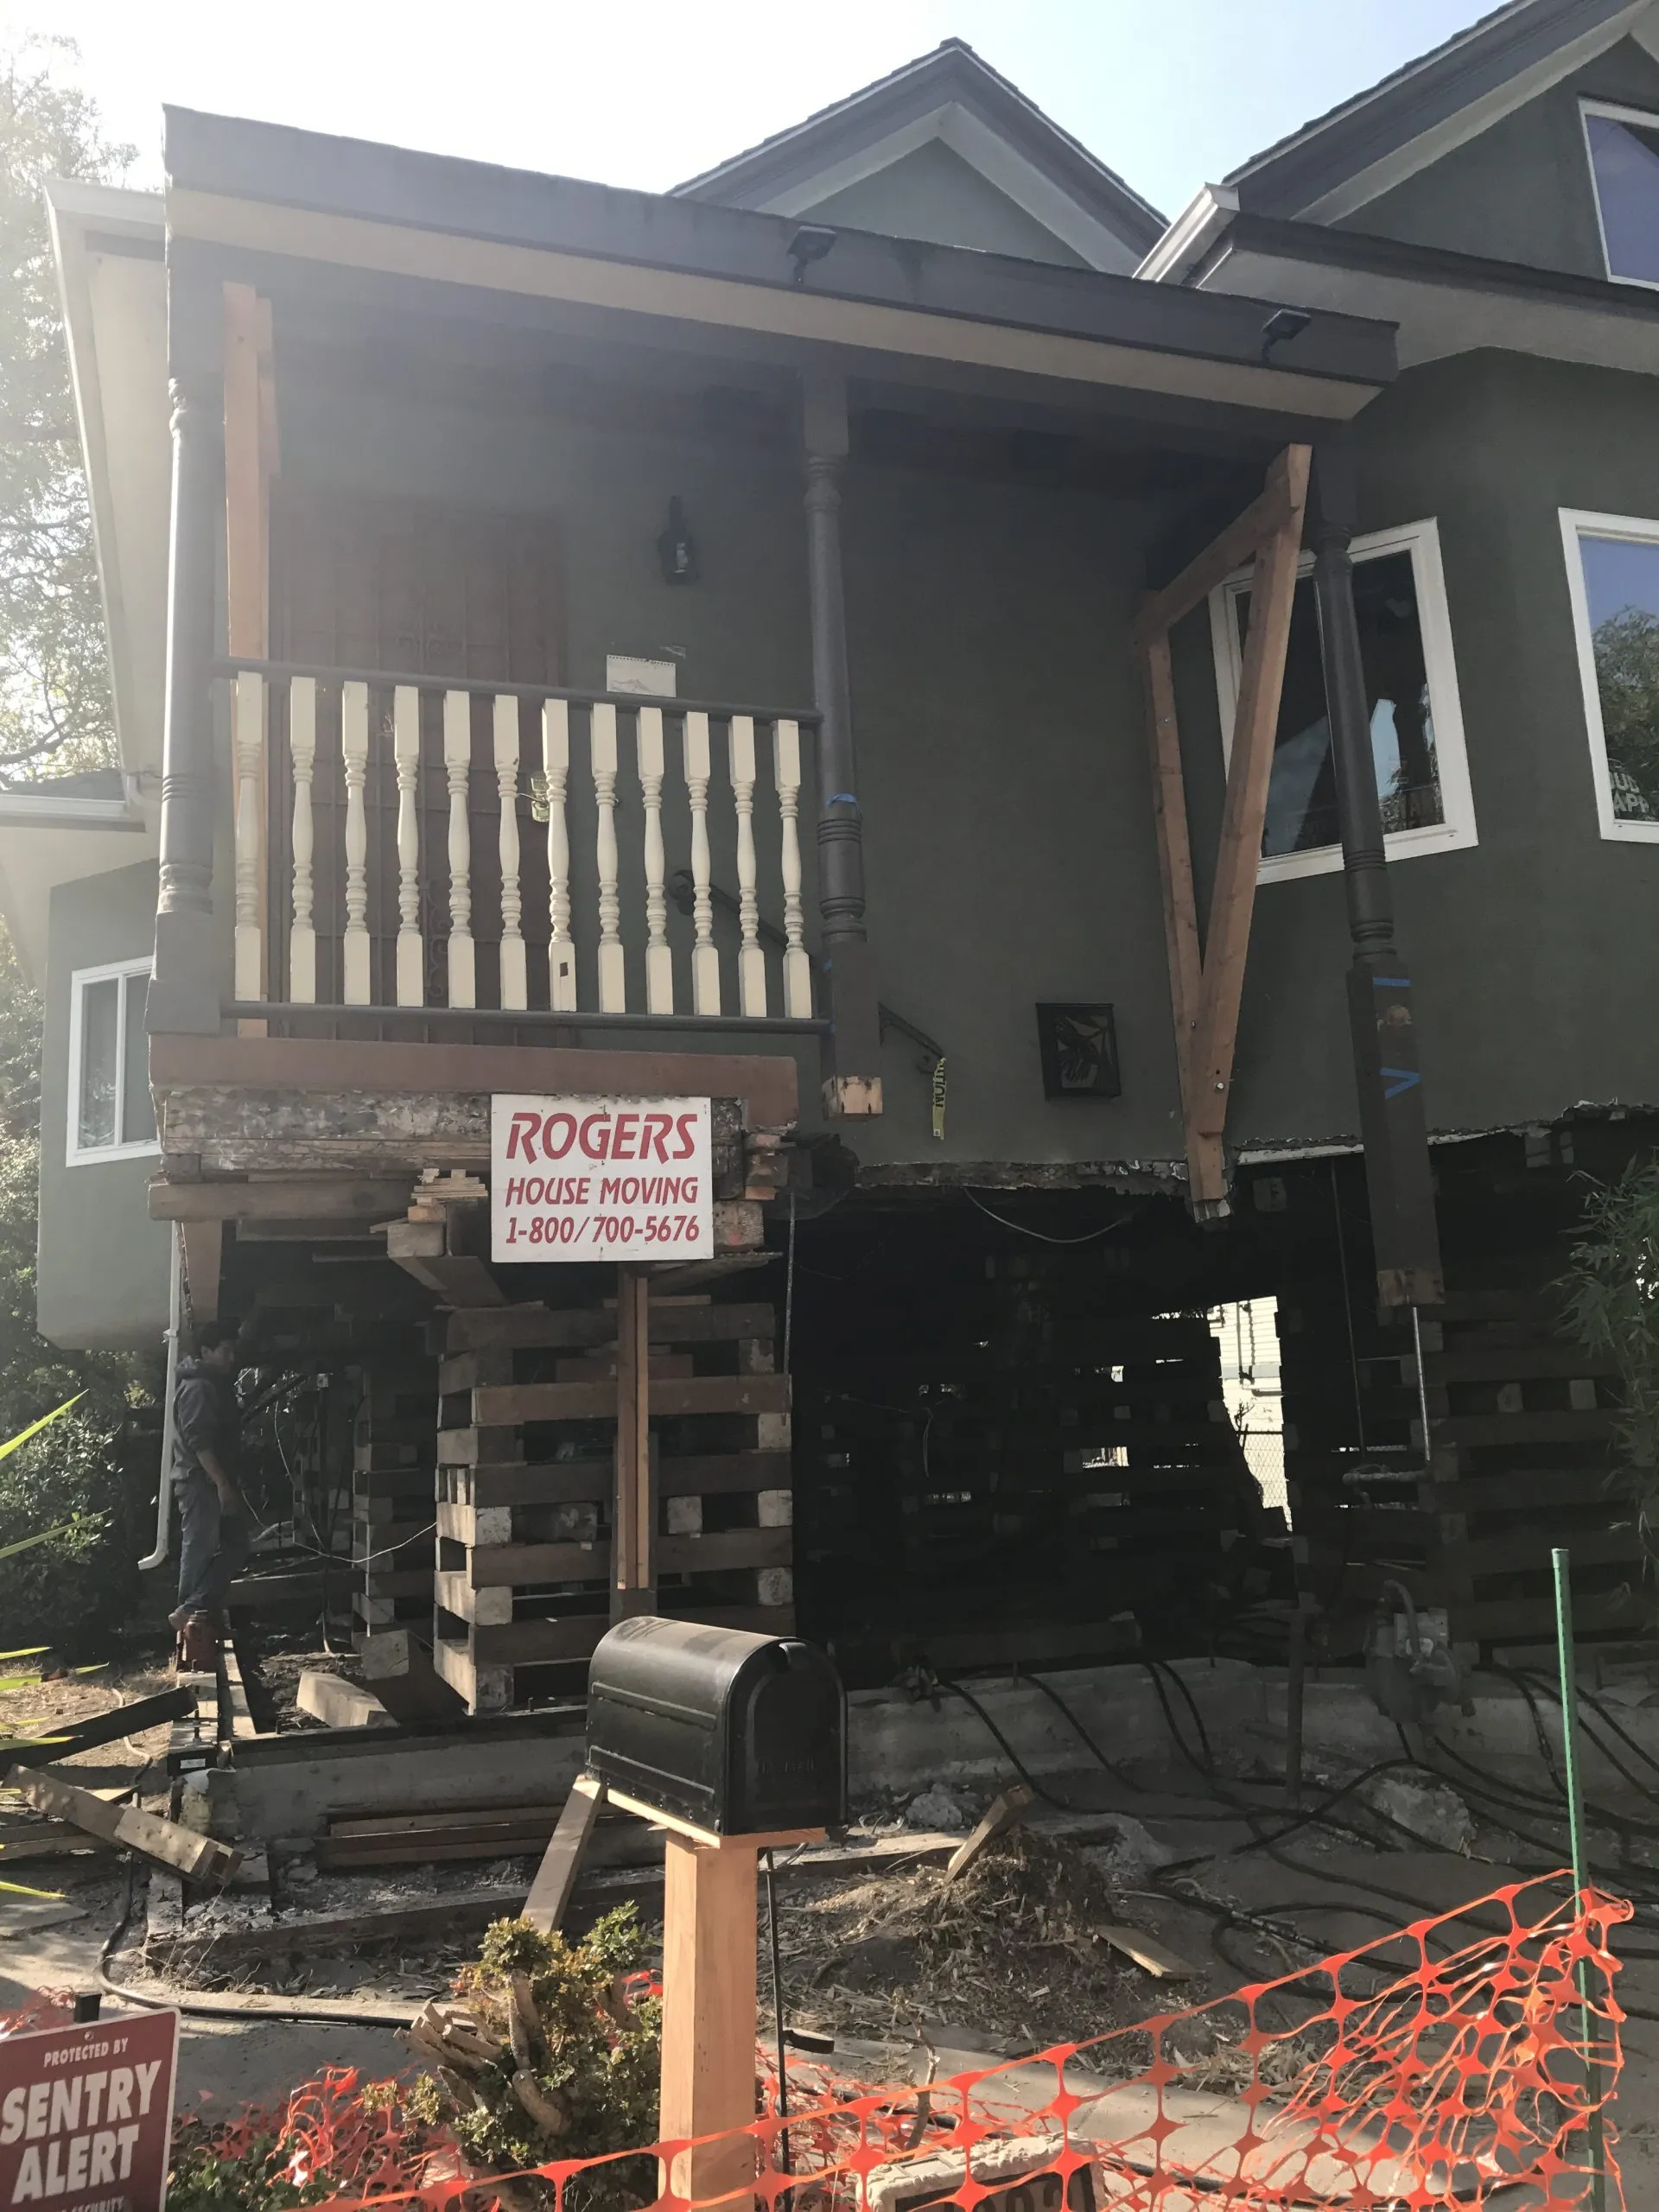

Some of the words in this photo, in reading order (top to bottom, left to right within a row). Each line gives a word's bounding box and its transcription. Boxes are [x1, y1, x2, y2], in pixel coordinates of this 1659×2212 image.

[505, 1112, 698, 1165] ROGERS
[505, 1177, 591, 1208] HOUSE
[599, 1176, 698, 1206] MOVING
[44, 2042, 109, 2068] PROTECTED
[112, 2037, 129, 2055] BY
[0, 2060, 162, 2145] SENTRY
[10, 2123, 140, 2205] ALERT
